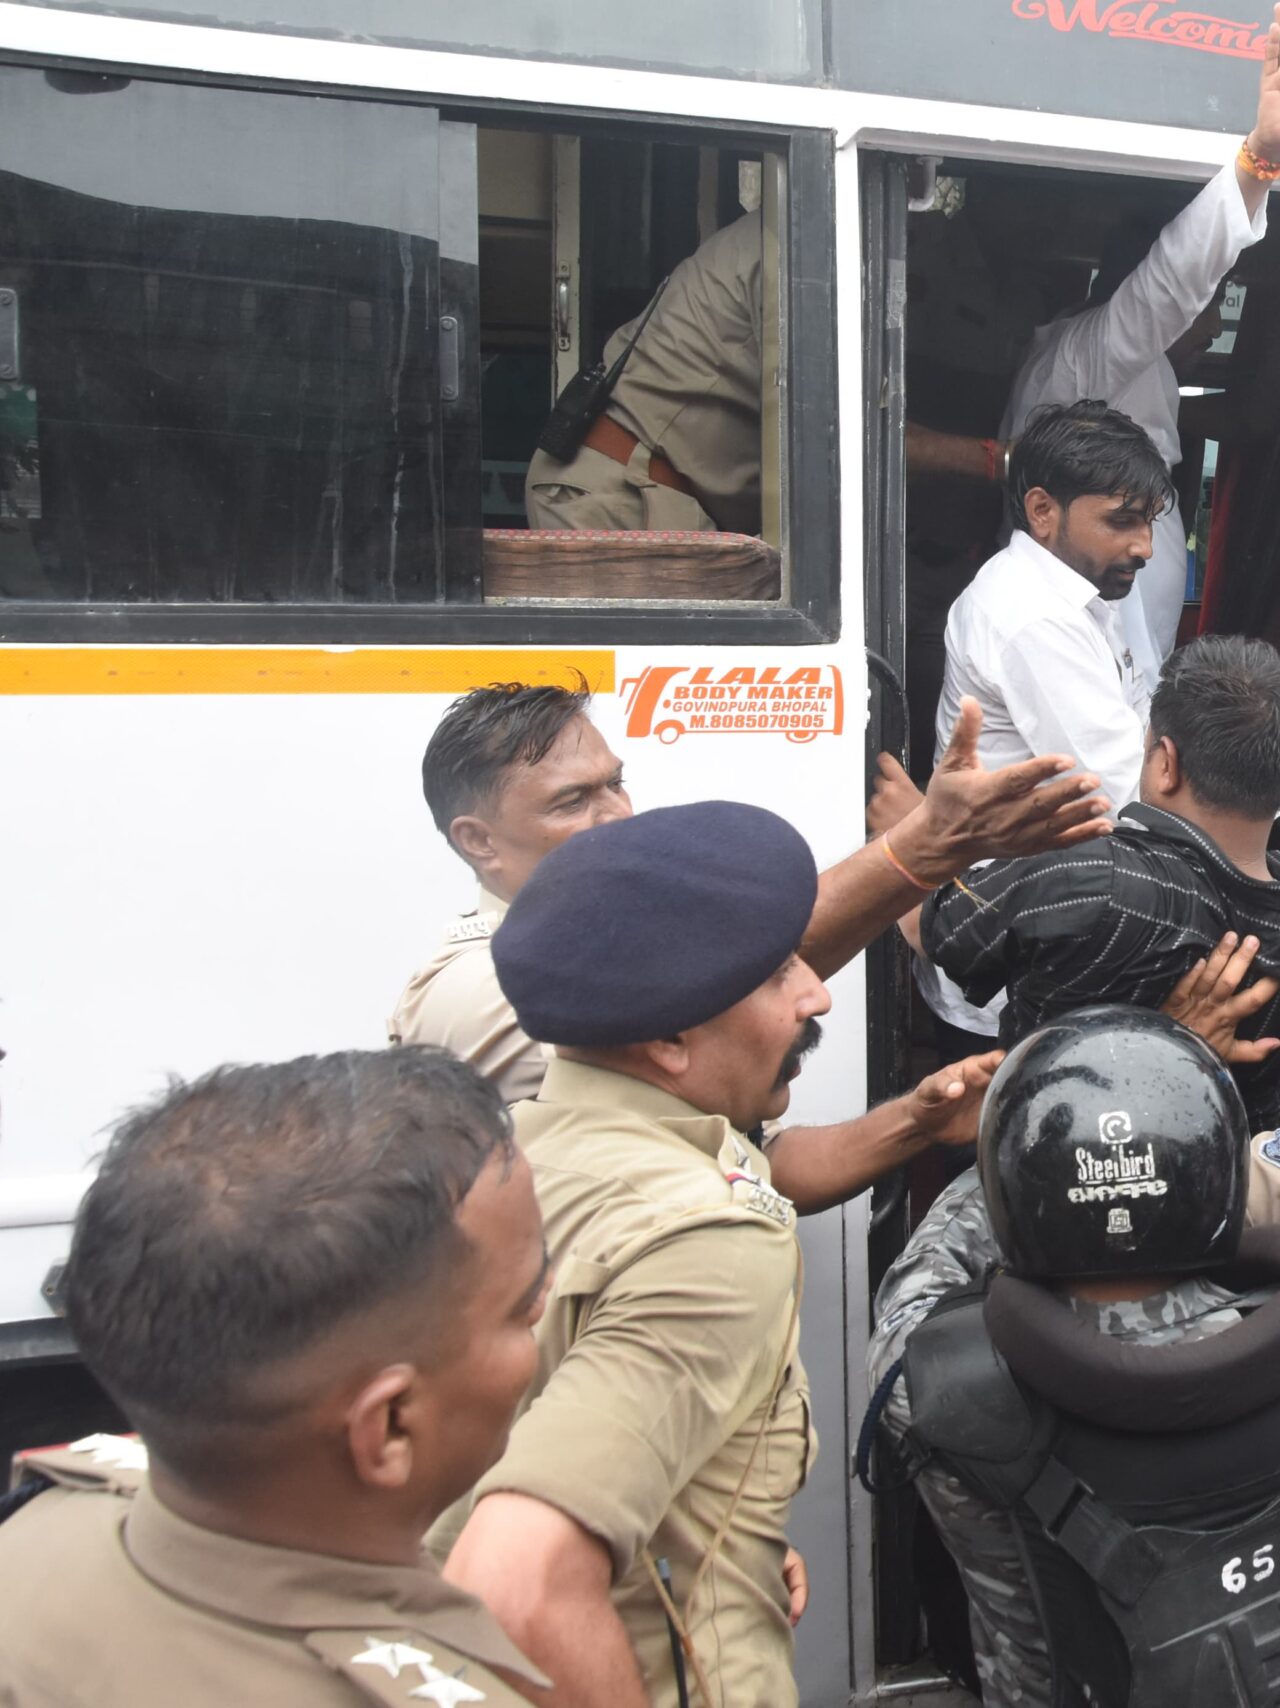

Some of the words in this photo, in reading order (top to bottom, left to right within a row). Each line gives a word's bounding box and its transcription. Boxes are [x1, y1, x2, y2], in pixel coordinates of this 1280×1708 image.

[688, 666, 822, 685] LALA
[673, 686, 742, 700] BODY
[746, 686, 833, 700] MAKER
[672, 701, 768, 713] GOVINDPURA
[771, 701, 828, 713] BHOPAL
[689, 714, 825, 729] M.8085070905
[1221, 1543, 1275, 1594] 65
